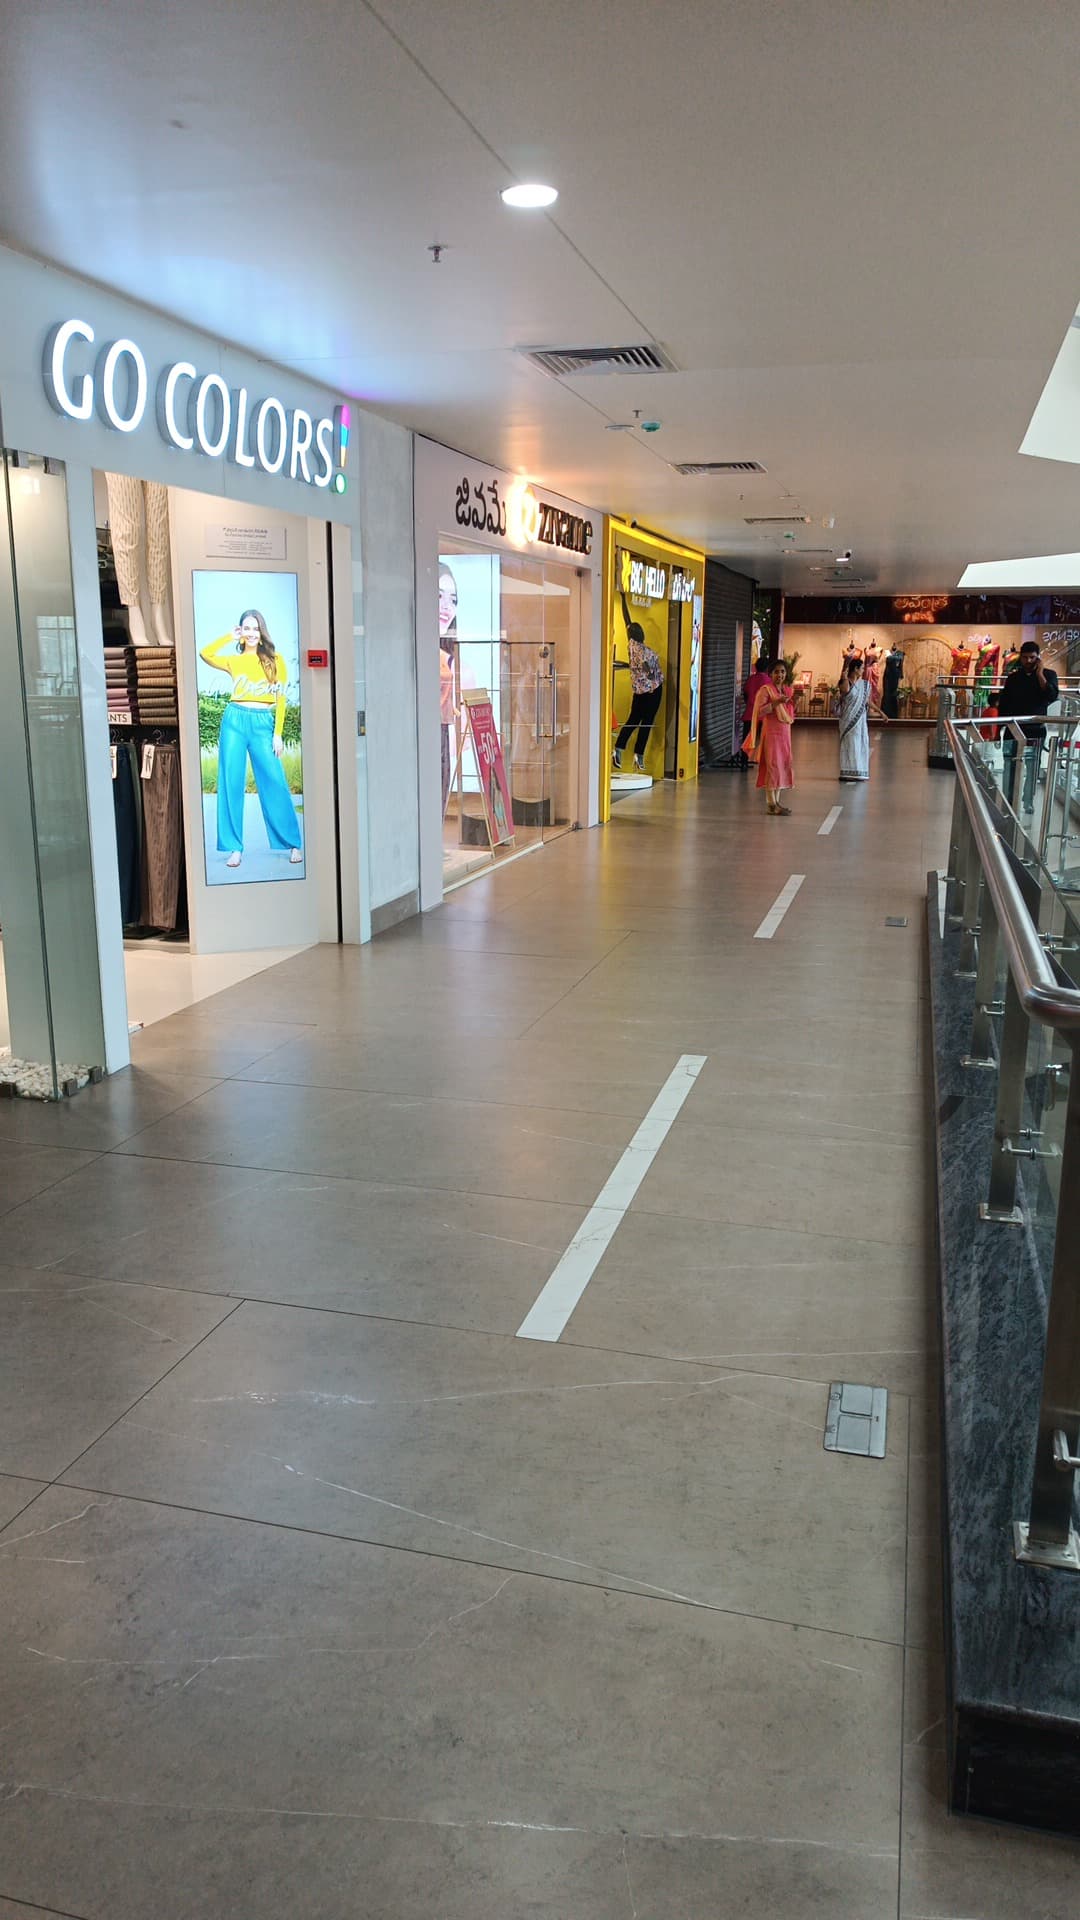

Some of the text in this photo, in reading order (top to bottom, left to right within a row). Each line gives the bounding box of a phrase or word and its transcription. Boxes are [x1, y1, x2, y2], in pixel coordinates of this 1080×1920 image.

[45, 319, 351, 493] GO COLORS!
[630, 560, 644, 594] BIG
[645, 565, 666, 599] HELLO
[107, 713, 128, 722] NTS
